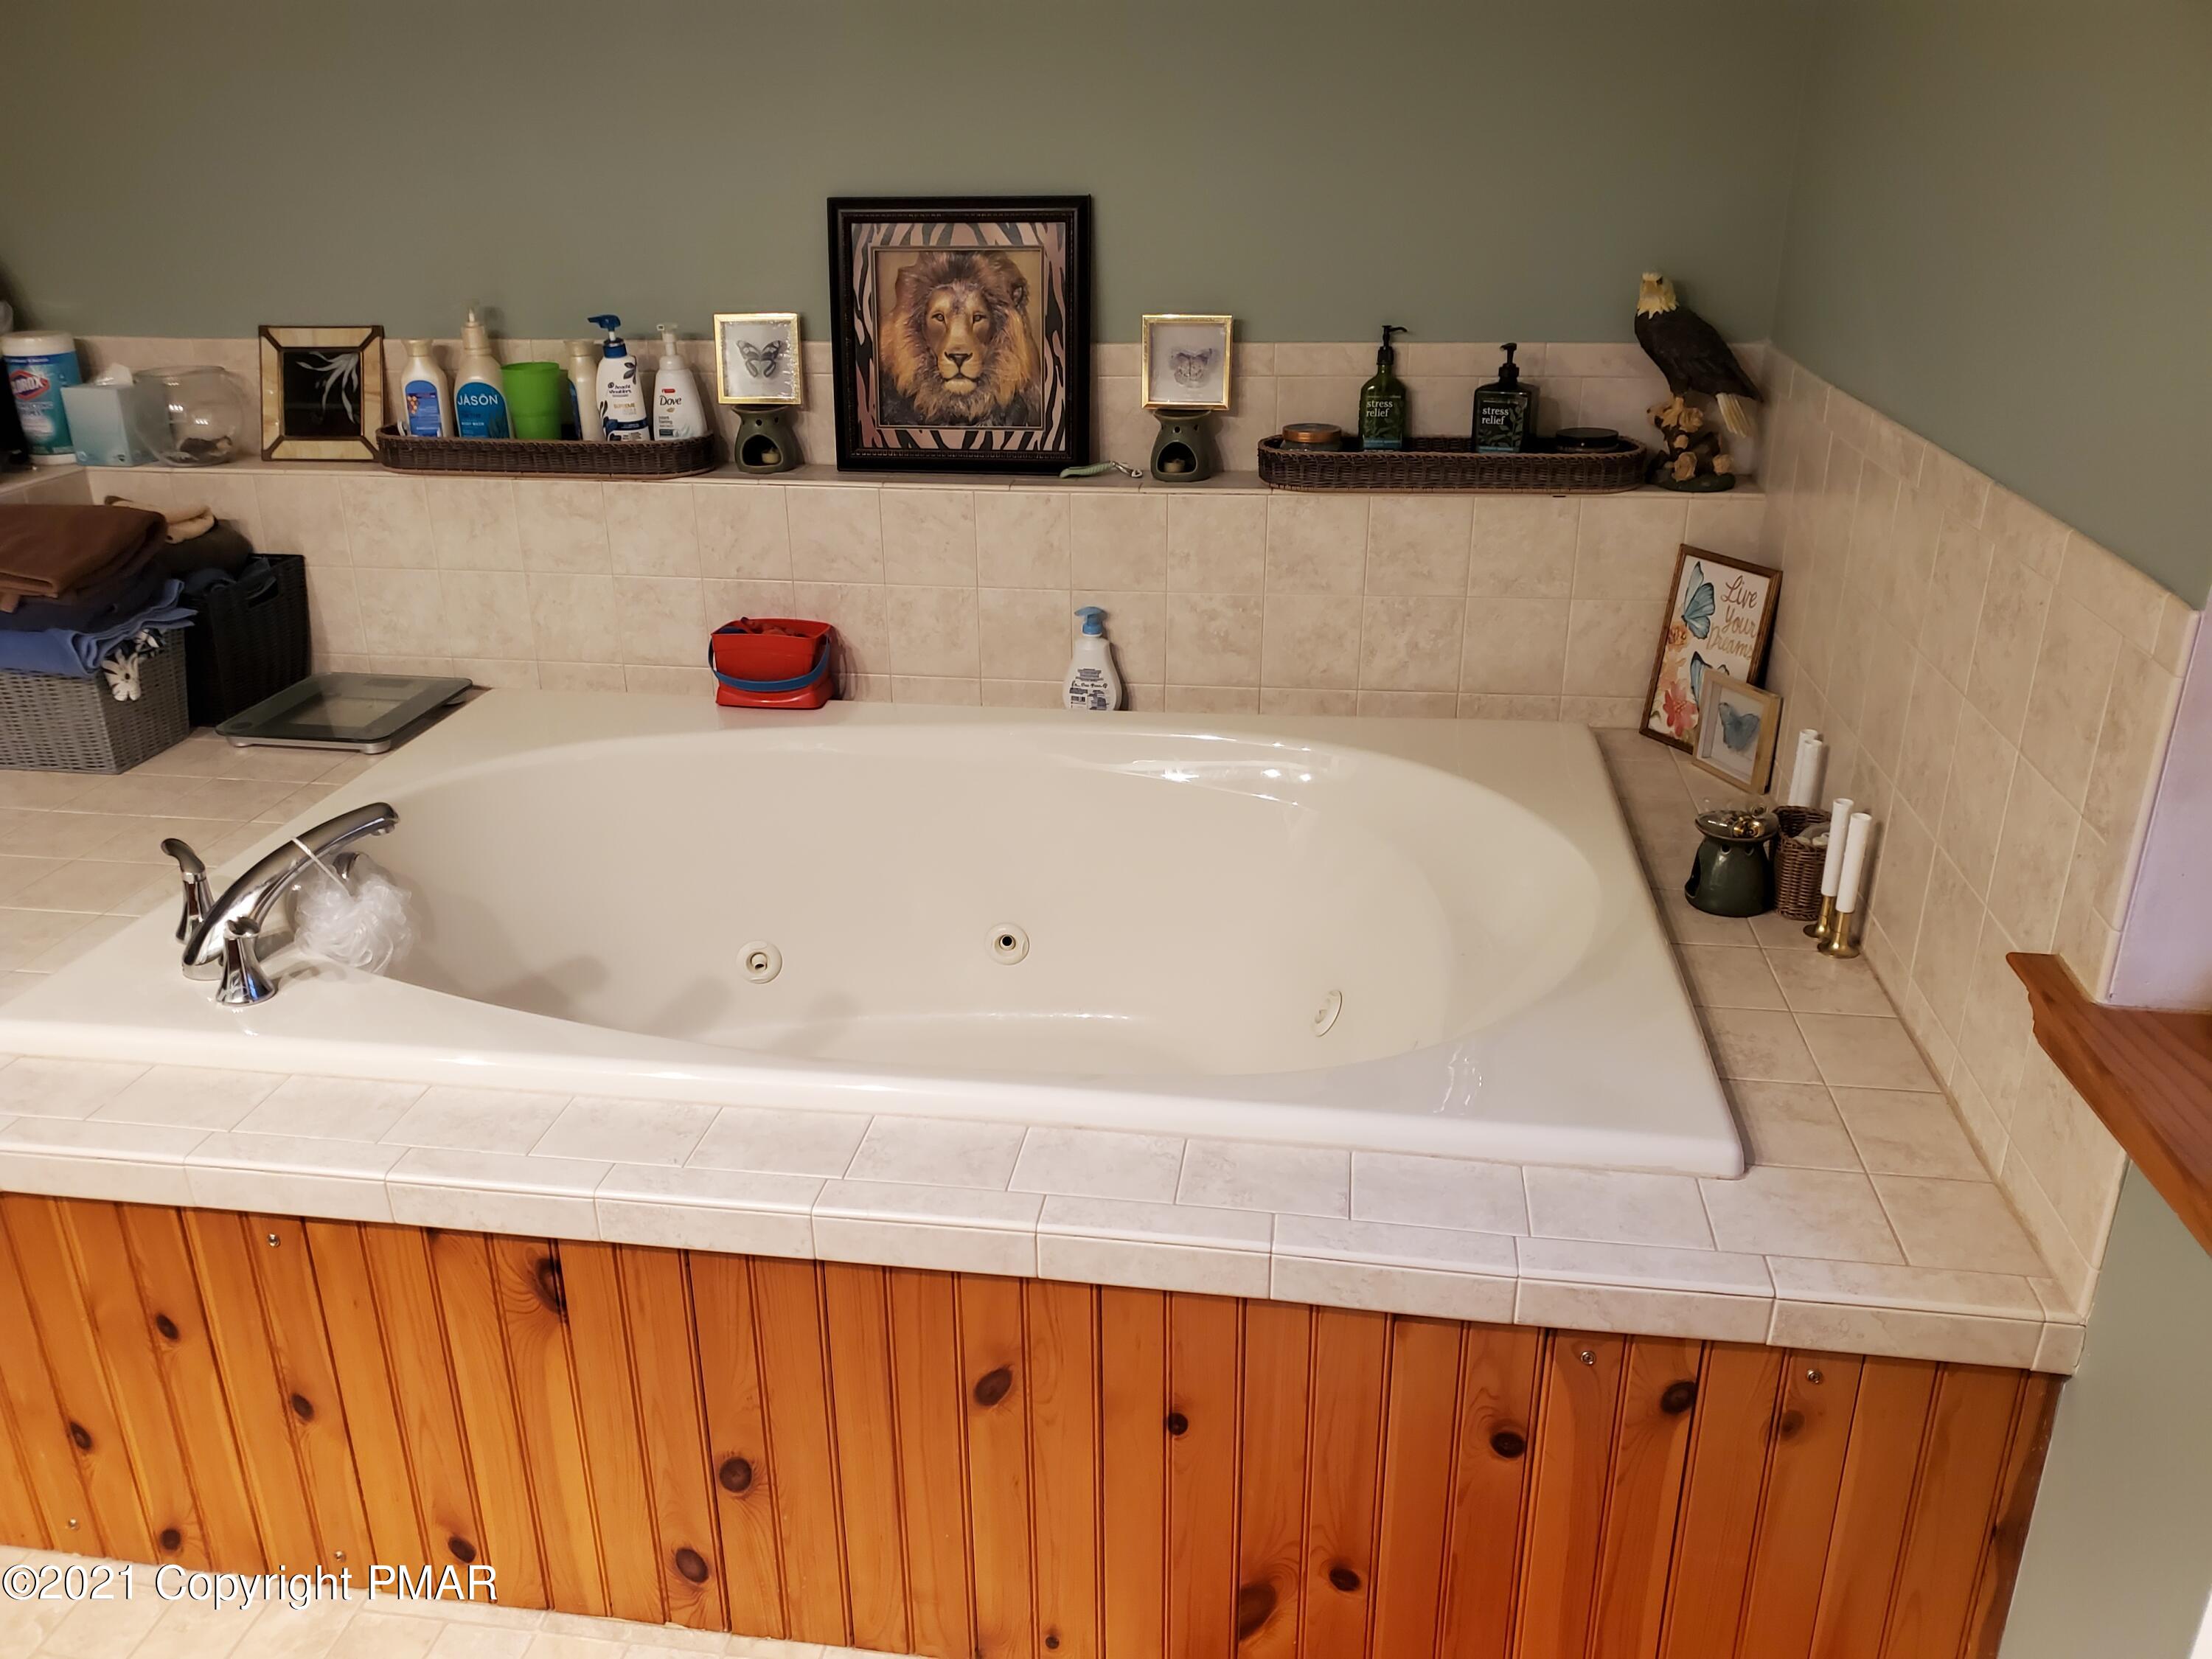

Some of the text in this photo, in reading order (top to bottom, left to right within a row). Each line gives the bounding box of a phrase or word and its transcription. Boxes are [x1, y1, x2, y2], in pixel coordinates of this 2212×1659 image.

[659, 395, 682, 406] Dove
[1366, 400, 1393, 408] stress
[1366, 408, 1390, 417] relief
[1482, 407, 1509, 416] stress
[1481, 415, 1506, 425] relief
[1720, 575, 1758, 609] Live
